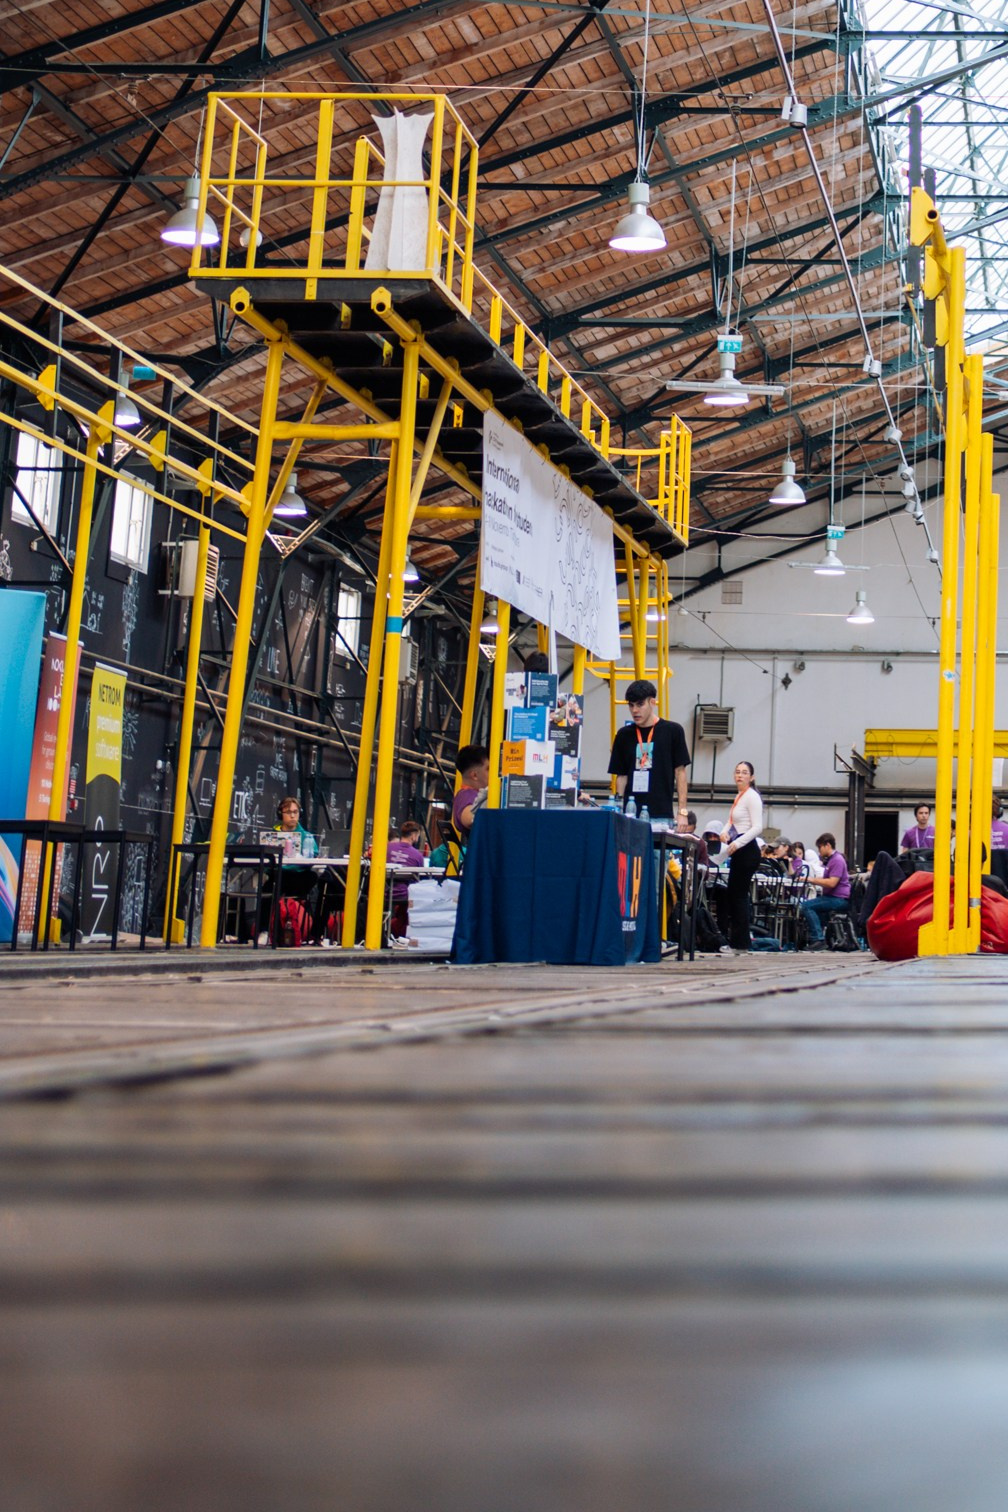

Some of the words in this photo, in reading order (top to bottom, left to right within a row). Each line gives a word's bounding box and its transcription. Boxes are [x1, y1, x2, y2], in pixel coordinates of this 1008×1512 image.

[98, 684, 121, 707] NETROM
[97, 713, 121, 734] premium
[95, 738, 119, 762] software
